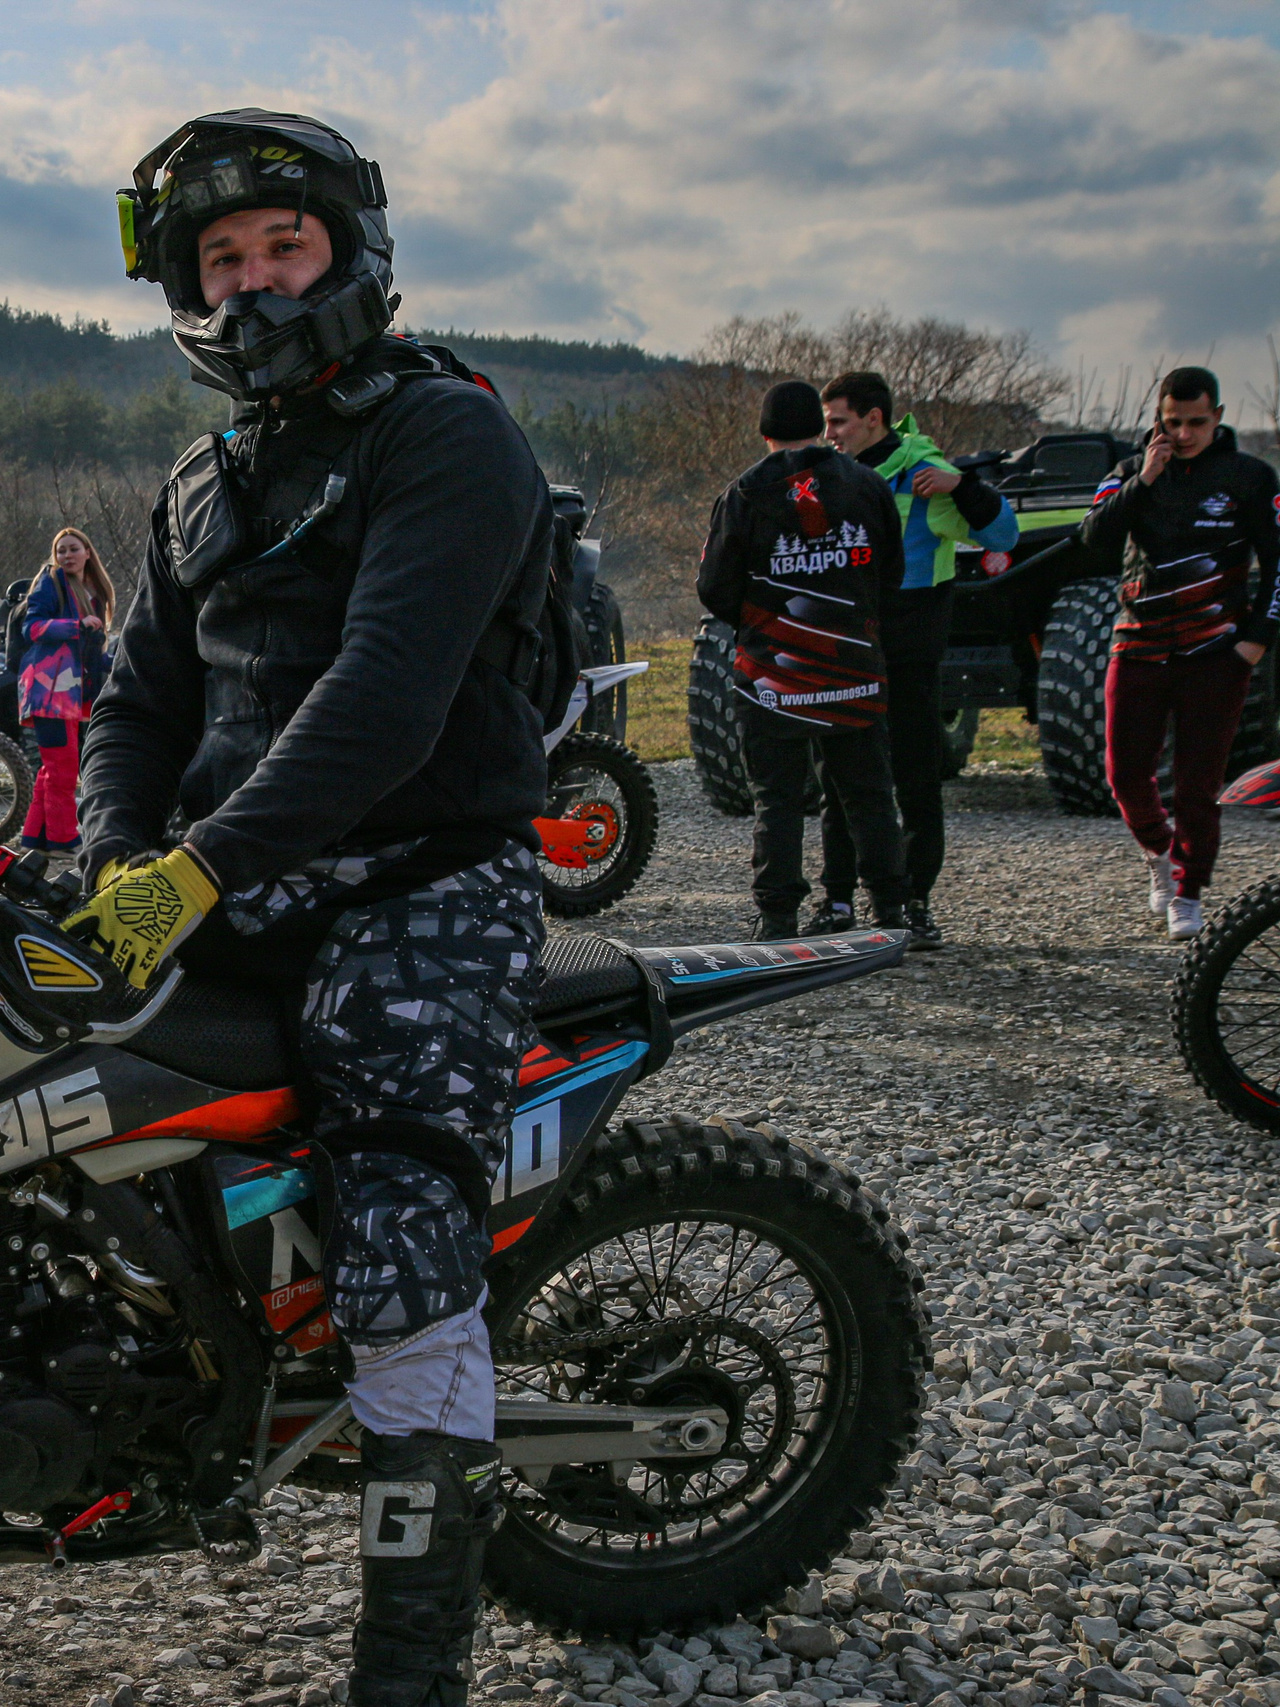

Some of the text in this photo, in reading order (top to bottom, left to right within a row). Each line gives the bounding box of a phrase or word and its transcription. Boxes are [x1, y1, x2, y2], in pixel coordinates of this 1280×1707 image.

[770, 547, 872, 575] КВАДРО 93
[780, 682, 879, 706] WWW.KVADRO93.RU
[360, 1480, 437, 1558] G
